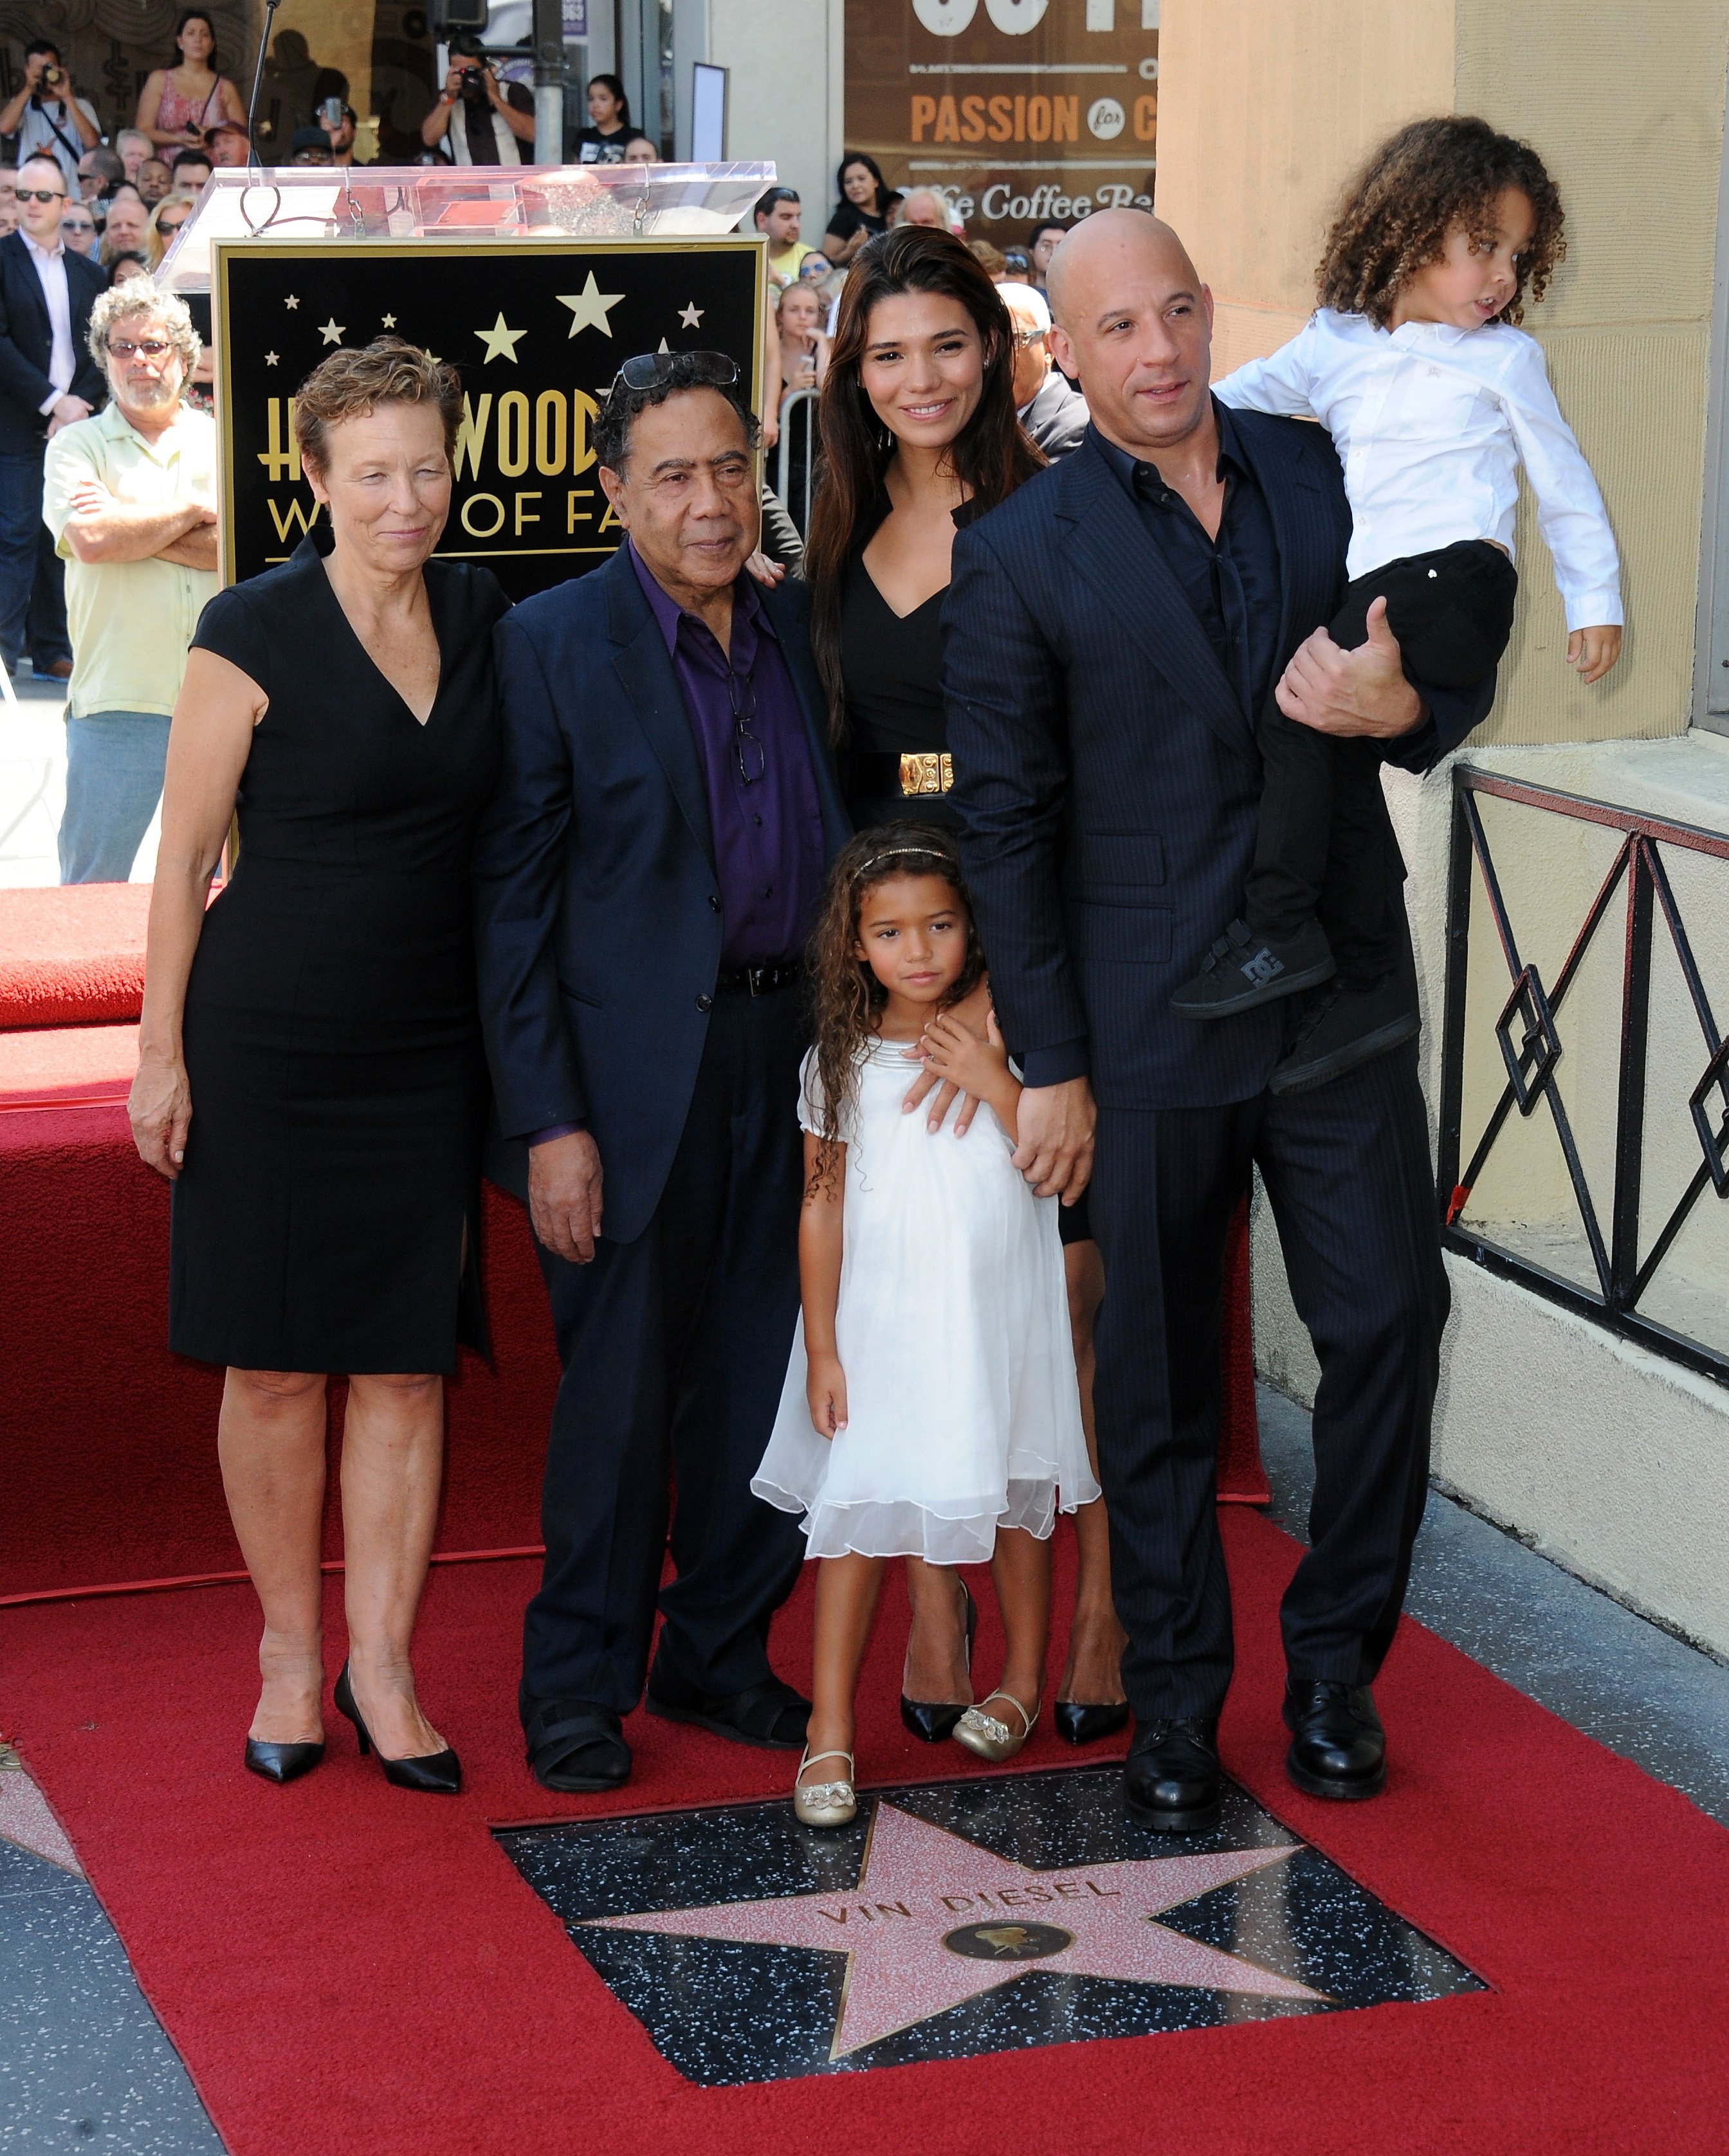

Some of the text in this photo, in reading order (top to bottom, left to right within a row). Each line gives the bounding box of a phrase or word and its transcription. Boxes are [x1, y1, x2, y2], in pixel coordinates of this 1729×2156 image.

[910, 95, 1079, 143] PASSION
[1094, 105, 1121, 131] for
[982, 183, 1092, 220] Coffee
[1095, 183, 1155, 216] Be
[257, 388, 599, 482] HWOOD
[461, 491, 543, 538] OF
[817, 1881, 1121, 1924] VIN DIESEL
